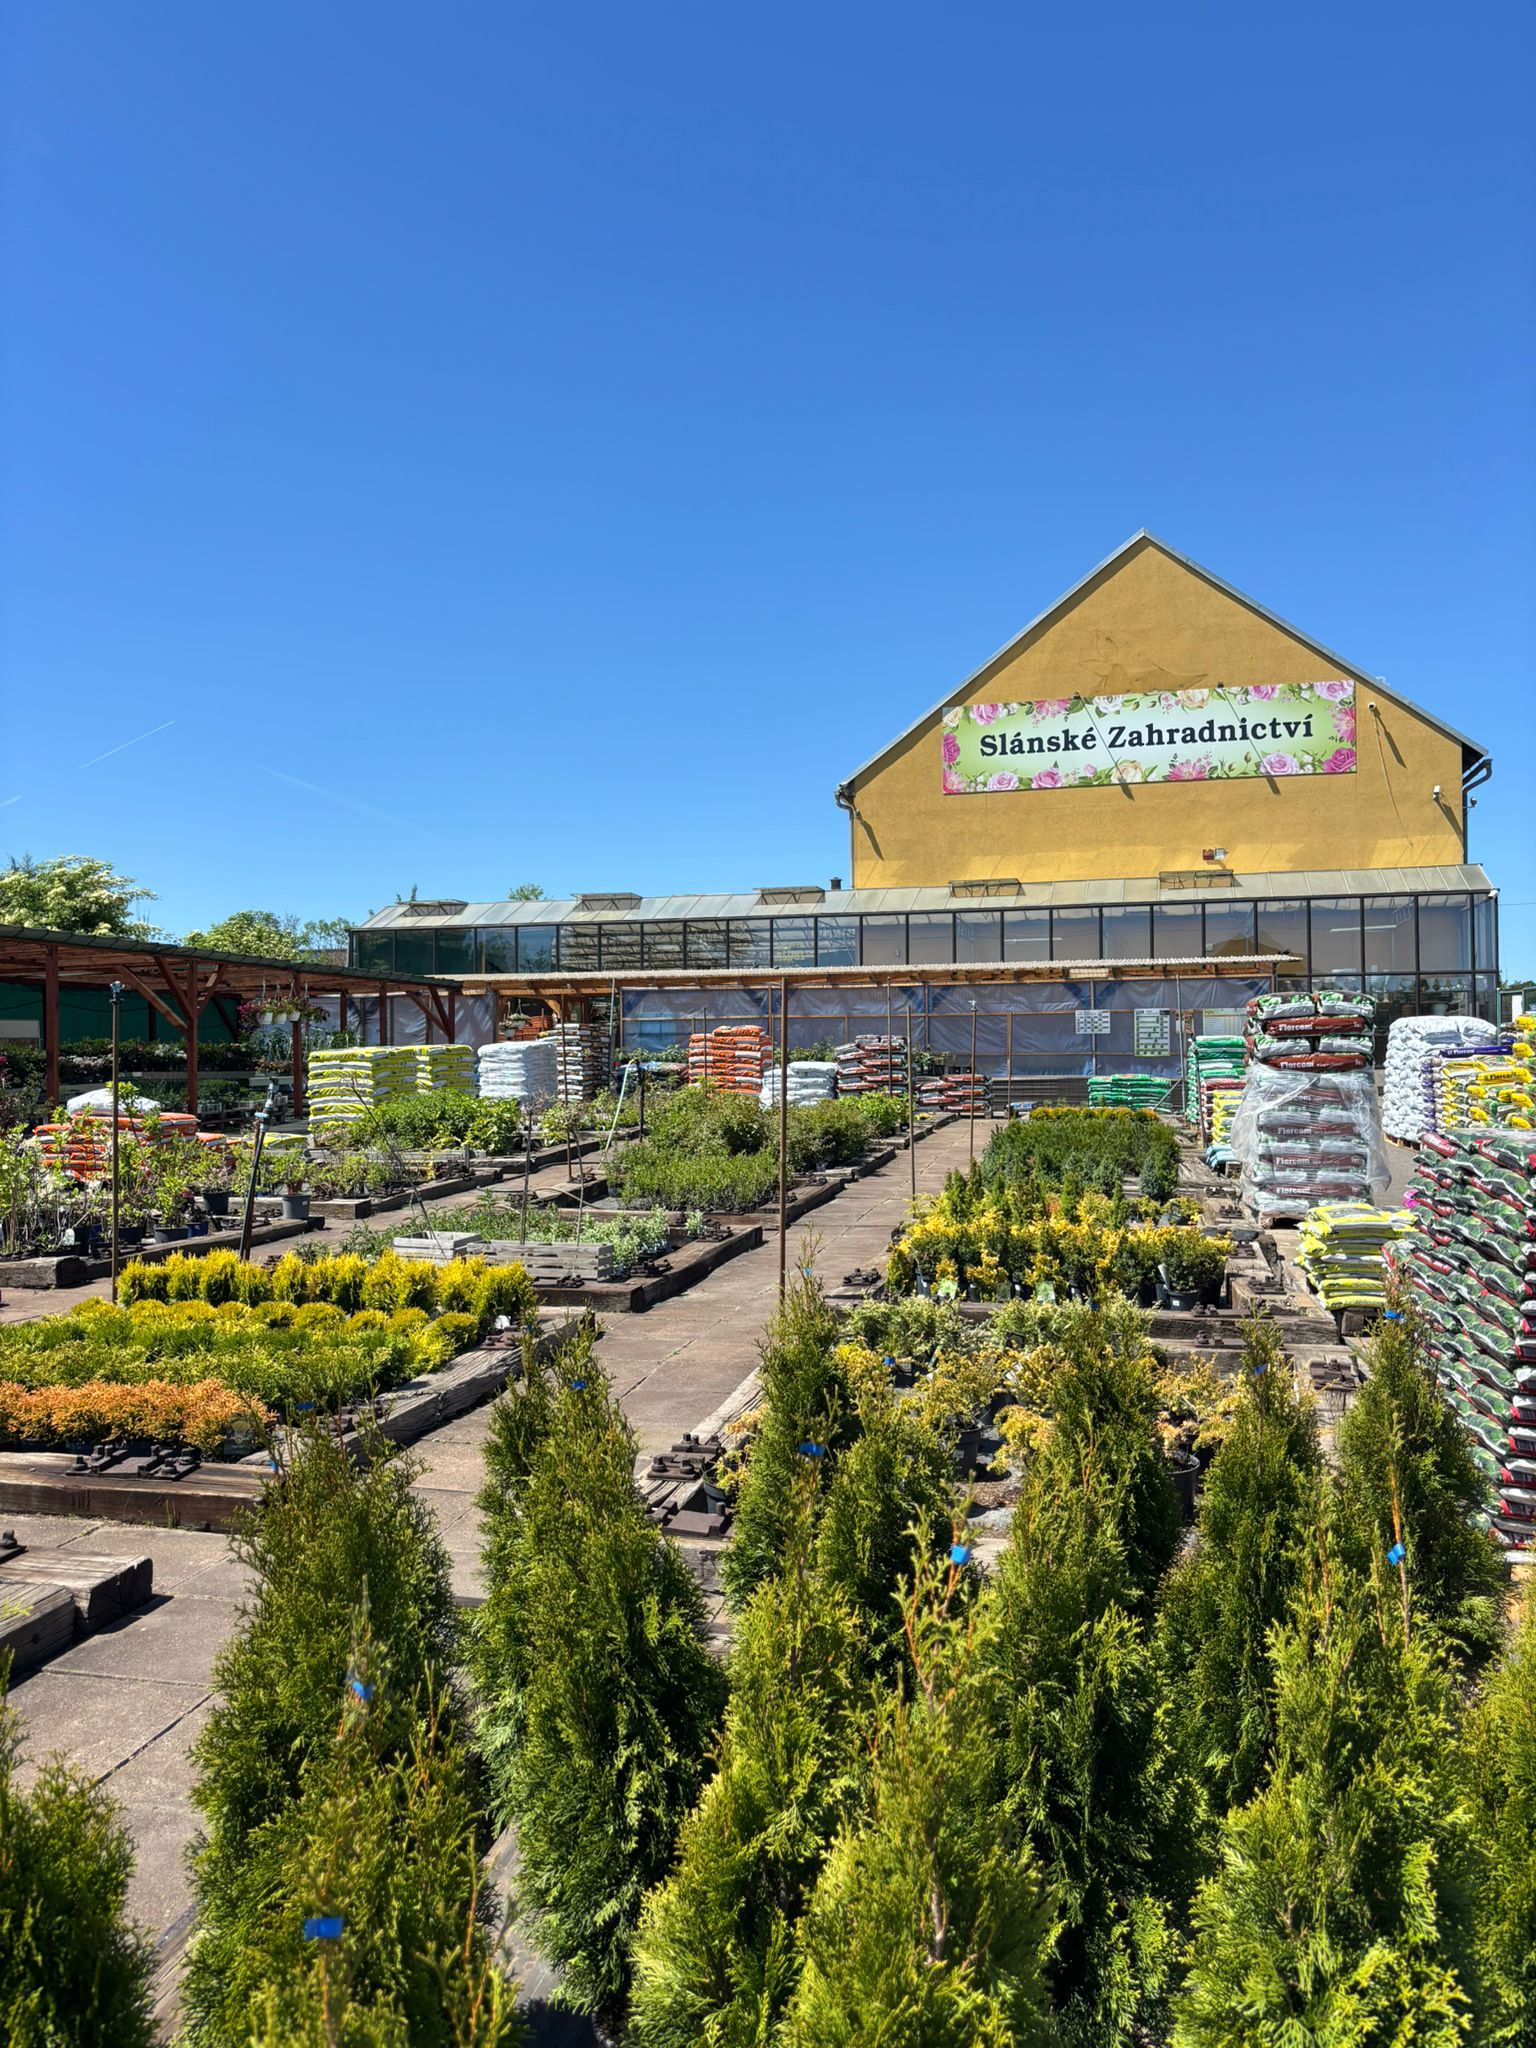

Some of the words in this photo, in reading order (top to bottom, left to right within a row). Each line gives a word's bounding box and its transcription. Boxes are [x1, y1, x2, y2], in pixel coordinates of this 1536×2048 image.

[980, 727, 1097, 757] Slánské
[1108, 713, 1313, 748] Zahradnictví
[1279, 1022, 1313, 1031] Florcom
[1280, 1060, 1314, 1069] Florcom
[1277, 1127, 1312, 1135] Florcom
[1276, 1157, 1310, 1165] Florcom
